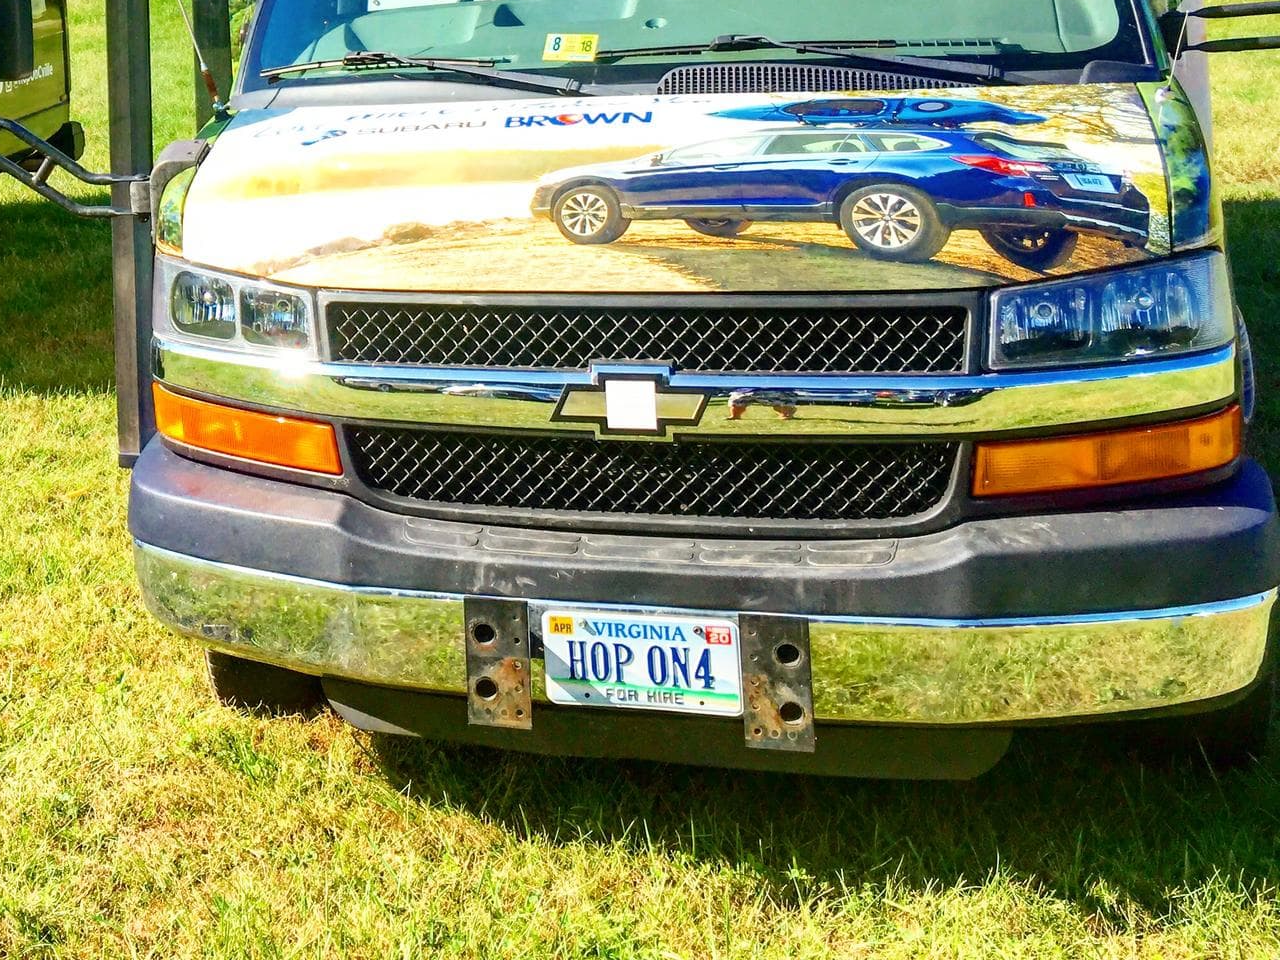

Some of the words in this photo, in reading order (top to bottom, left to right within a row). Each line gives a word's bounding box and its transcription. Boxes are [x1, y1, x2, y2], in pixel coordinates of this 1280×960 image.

[553, 37, 561, 51] 8
[581, 40, 592, 52] 18
[357, 119, 488, 136] SUBARU
[503, 110, 653, 129] BROWN
[554, 623, 572, 633] APR
[592, 622, 686, 641] VIRGINIA
[709, 632, 730, 643] 20
[567, 640, 634, 683] HOP
[647, 645, 715, 690] ON4
[606, 688, 638, 702] FOR
[647, 690, 684, 704] HIRE
